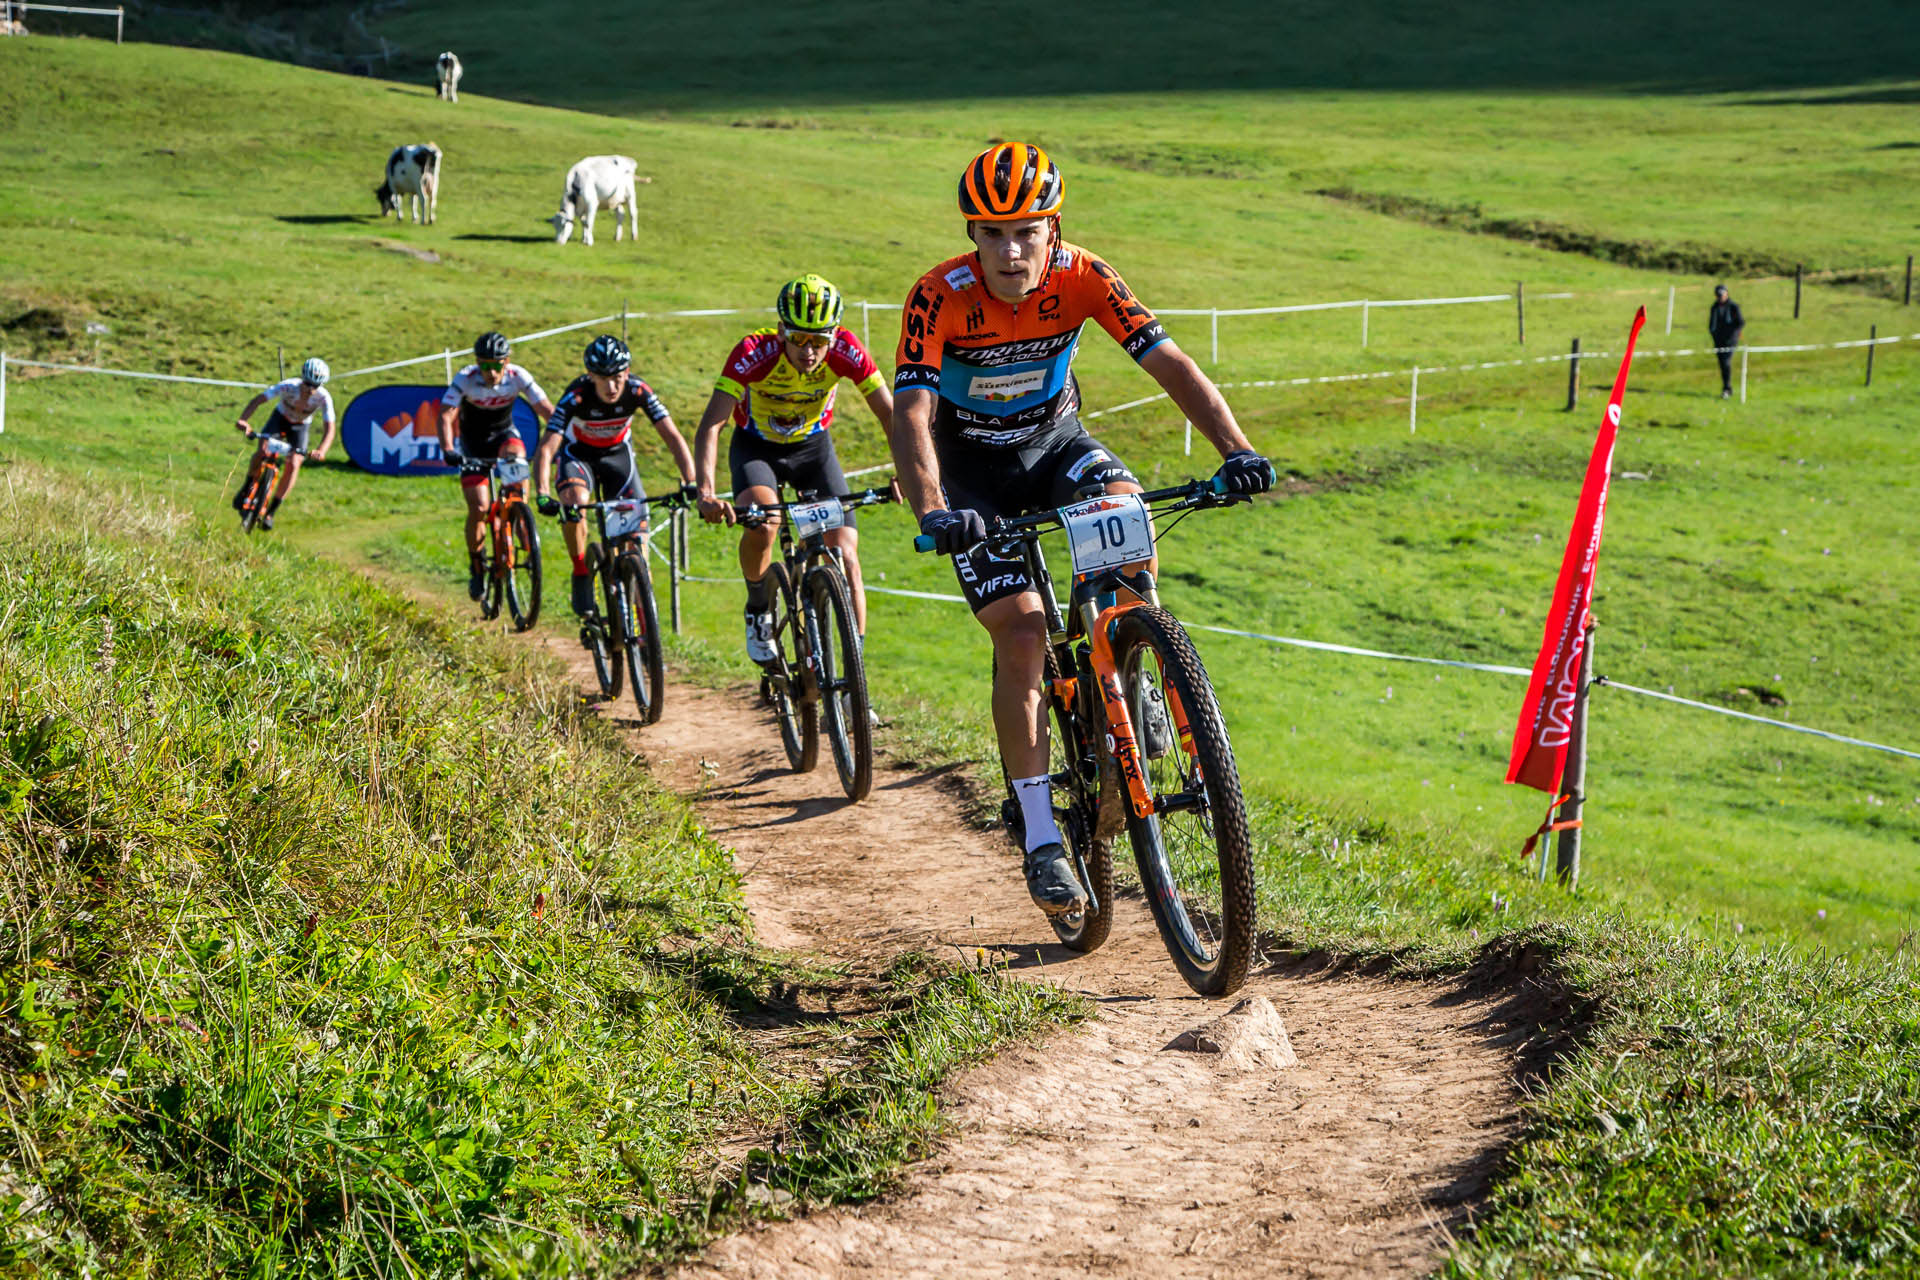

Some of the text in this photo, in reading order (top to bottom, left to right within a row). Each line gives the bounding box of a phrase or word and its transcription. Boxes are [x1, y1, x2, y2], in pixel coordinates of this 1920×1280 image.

[1091, 260, 1152, 319] CST
[904, 284, 930, 363] CST
[926, 292, 944, 336] TIRES
[956, 406, 1047, 425] BLAKS
[807, 506, 829, 522] 36
[1092, 515, 1126, 551] 10
[974, 573, 1027, 598] VIFRA
